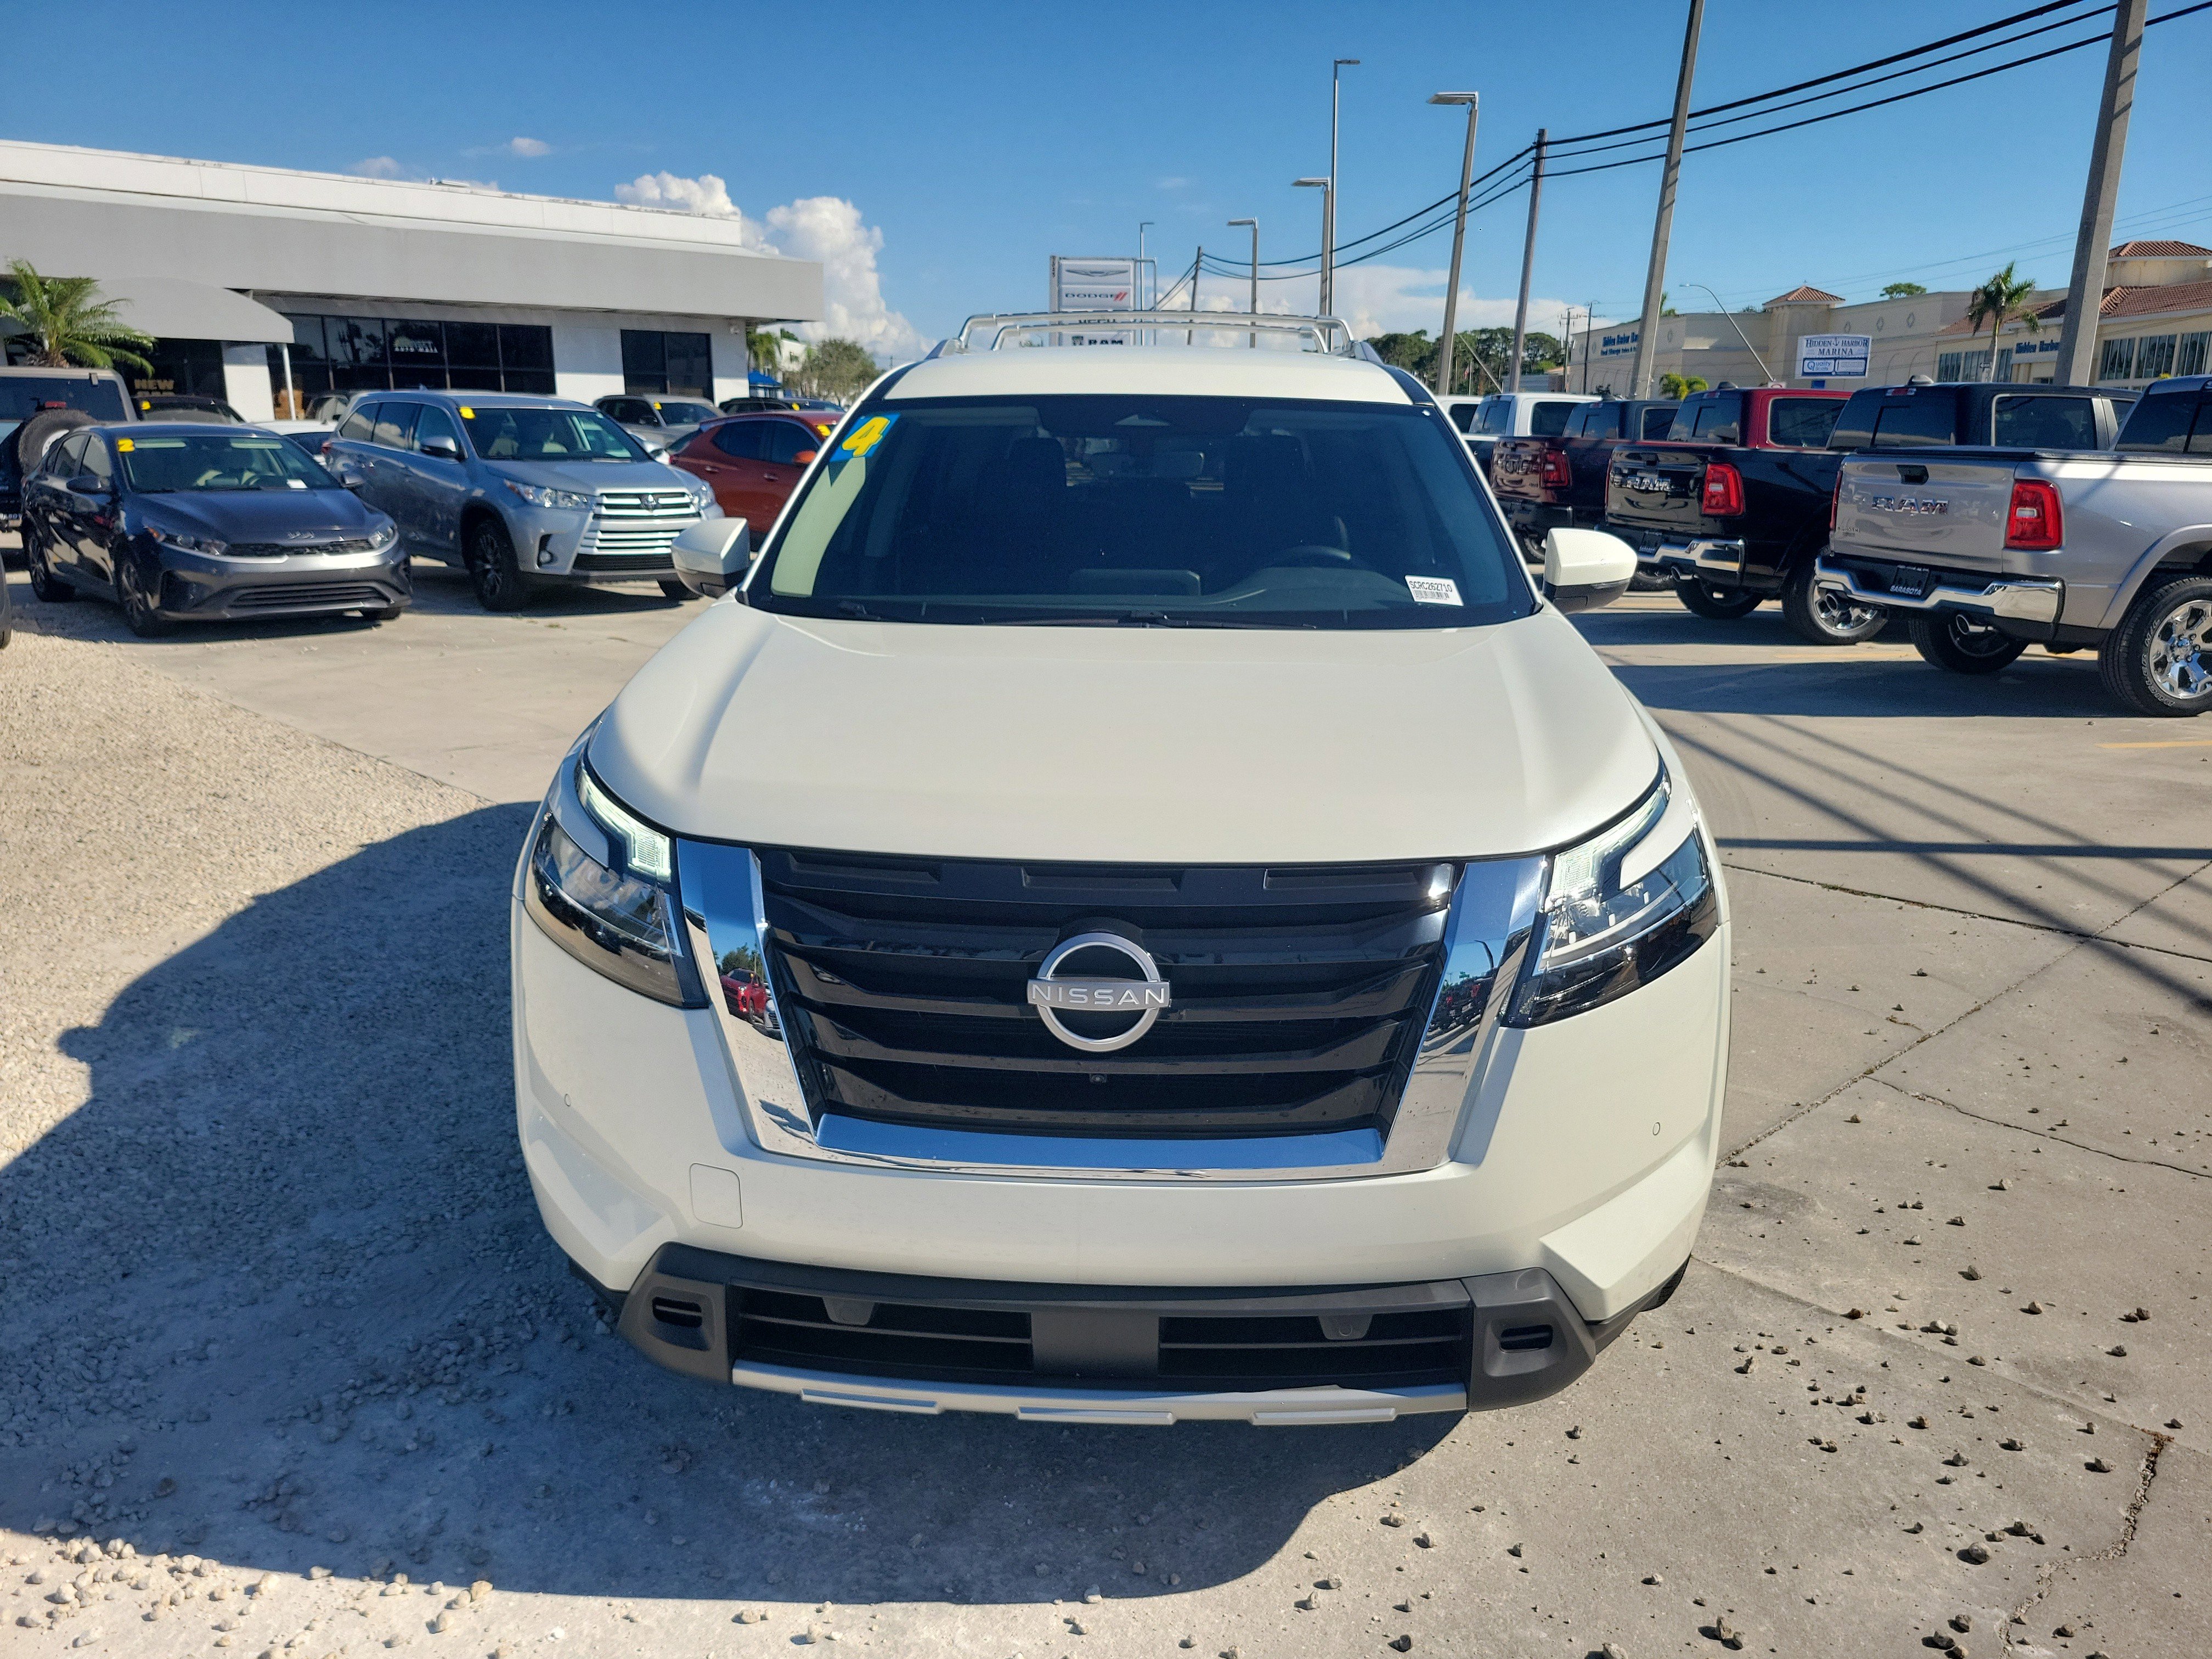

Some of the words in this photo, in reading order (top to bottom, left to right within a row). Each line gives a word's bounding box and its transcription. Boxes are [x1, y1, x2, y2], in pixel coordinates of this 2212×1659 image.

[1805, 339, 1832, 348] HIDDEN
[1841, 339, 1868, 347] HARBOR
[842, 416, 890, 457] 4
[1871, 496, 1949, 515] RAM
[1409, 581, 1453, 592] SCRC262710
[1890, 584, 1921, 596] SARASOTA
[1032, 984, 1164, 1005] NISSAN
